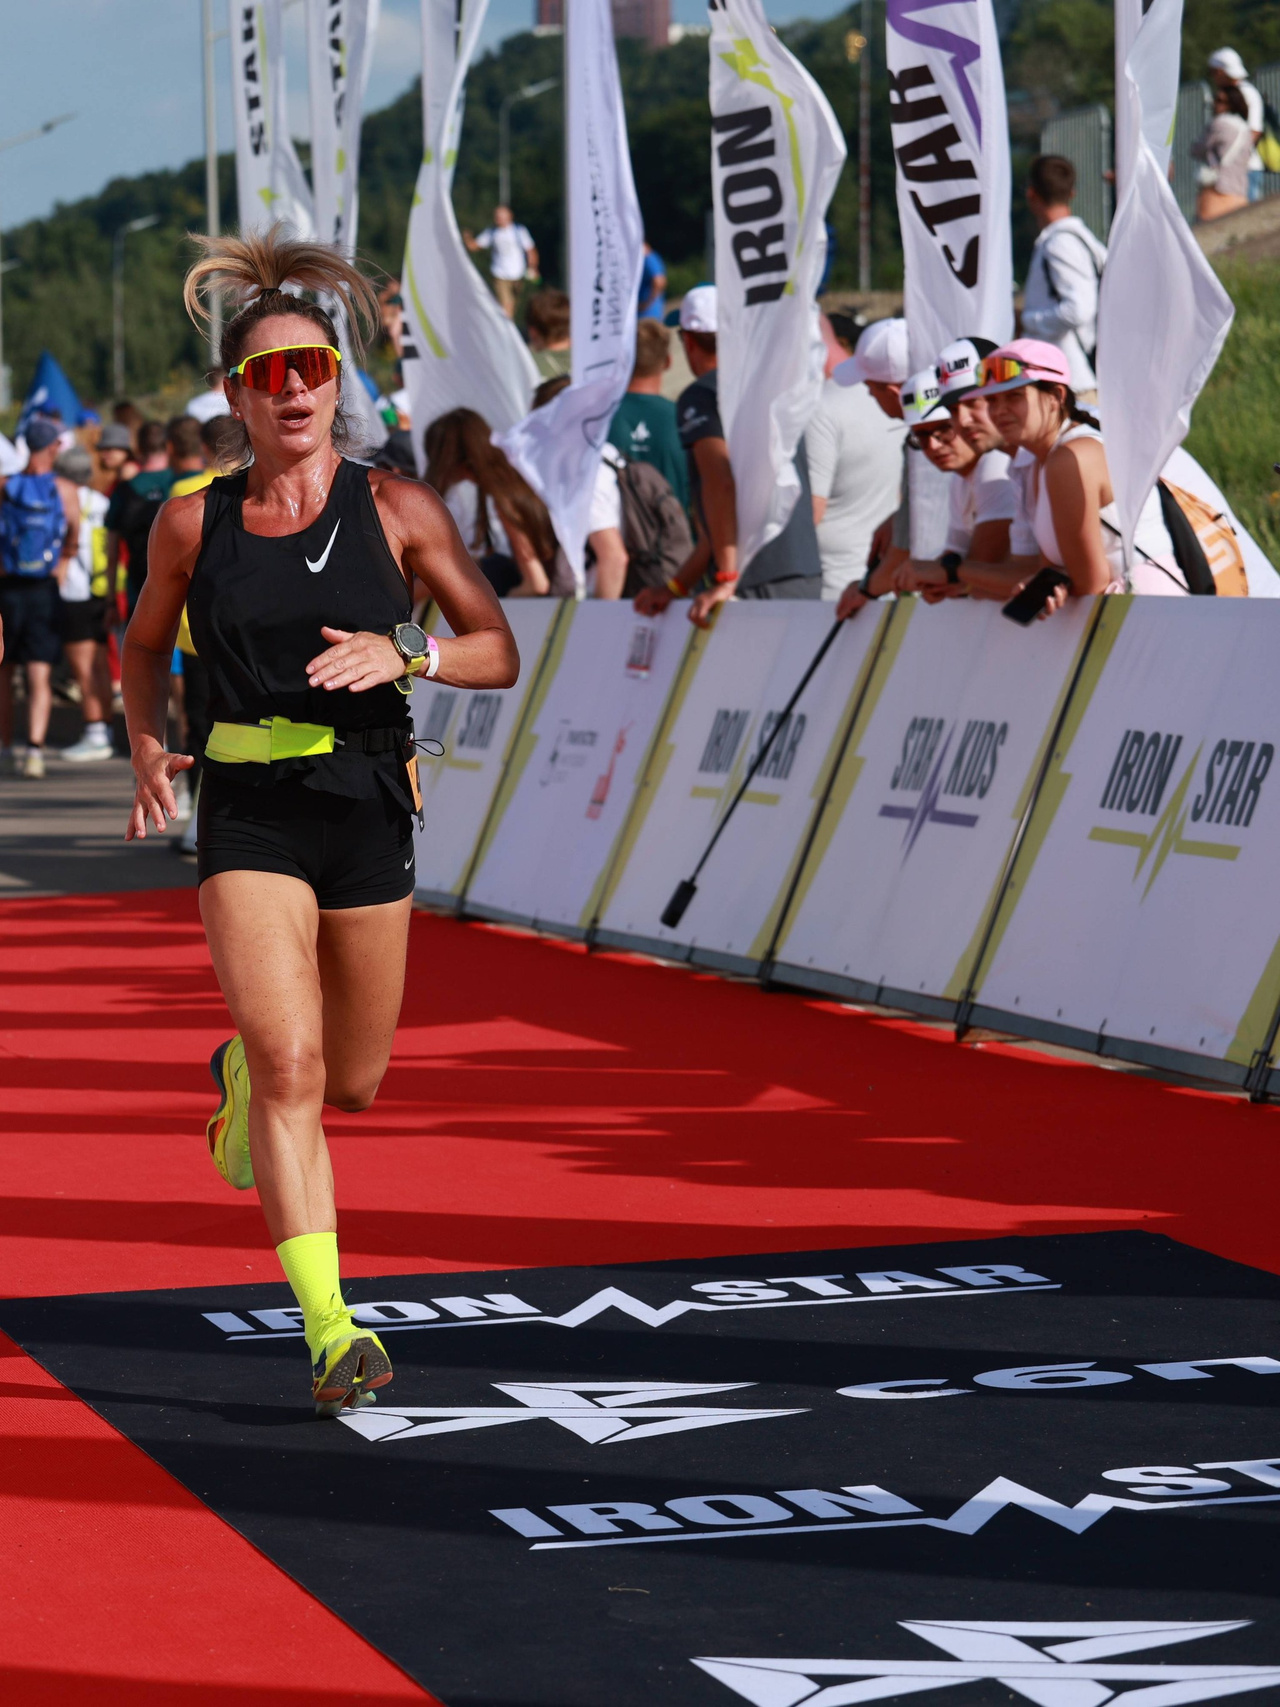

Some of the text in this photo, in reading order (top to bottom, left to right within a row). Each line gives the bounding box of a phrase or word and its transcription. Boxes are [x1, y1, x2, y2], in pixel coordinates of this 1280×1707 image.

[712, 105, 788, 307] IRON
[891, 716, 1009, 800] STAR KIDS
[1099, 729, 1275, 828] IRON STAR
[691, 1264, 1052, 1302] STAR
[488, 1485, 924, 1538] IRON
